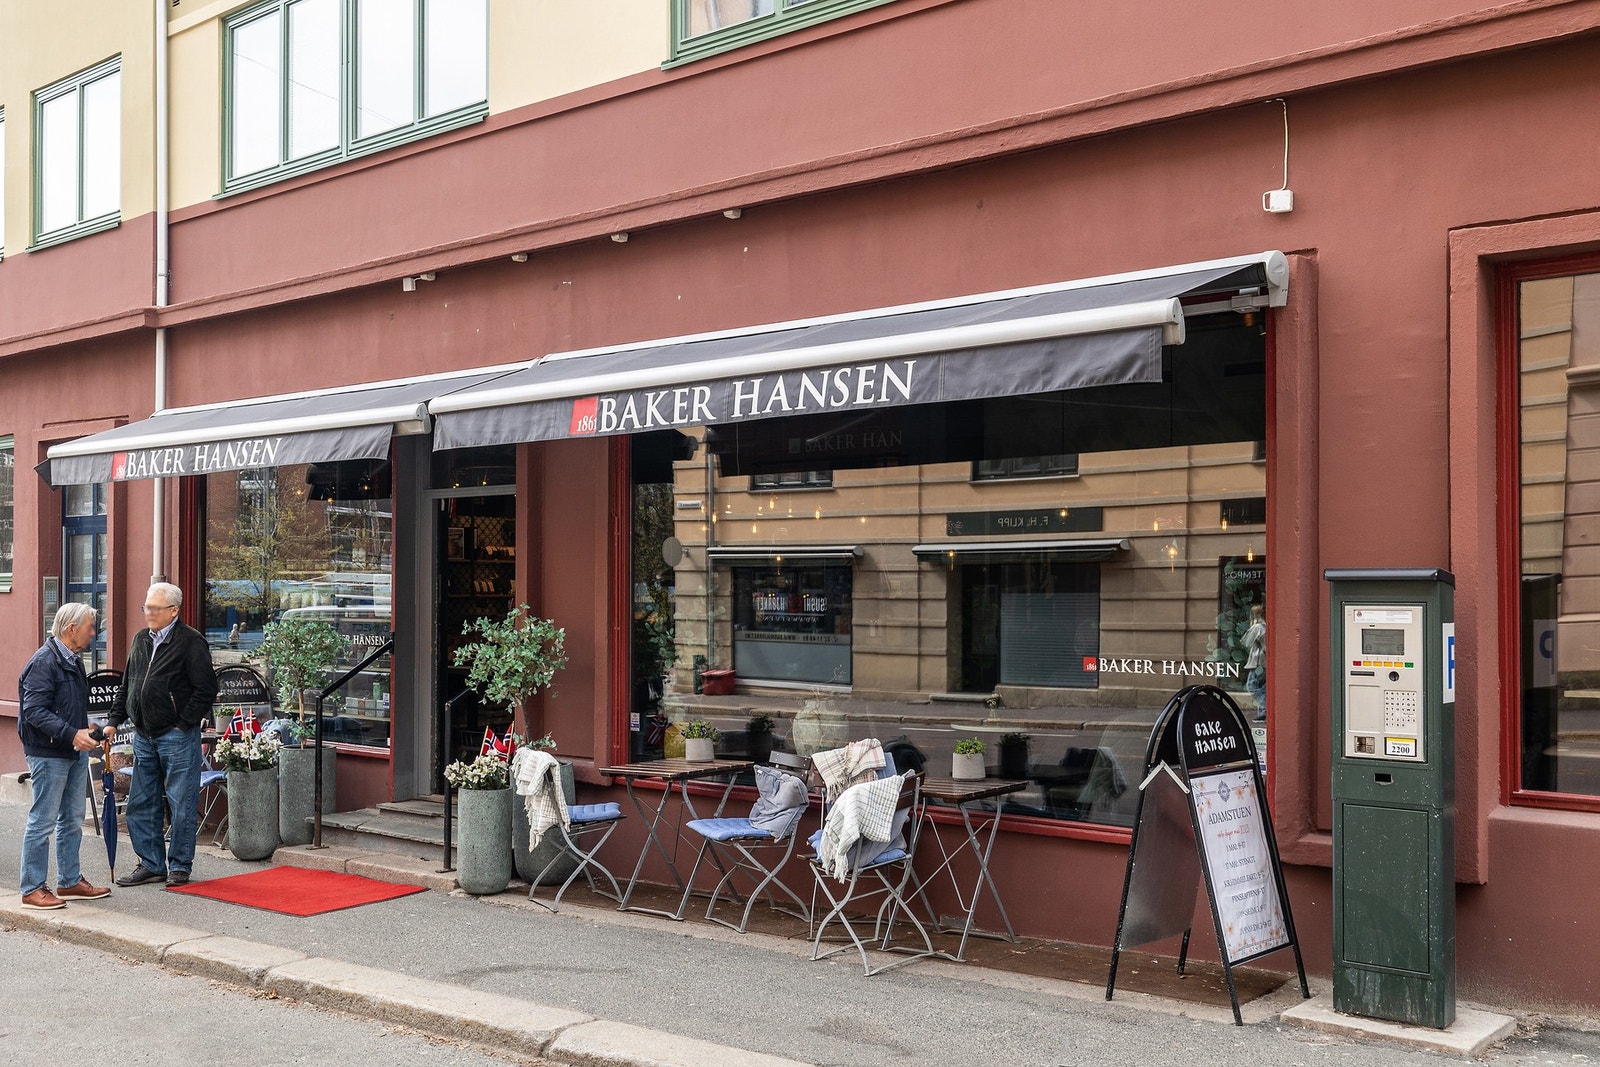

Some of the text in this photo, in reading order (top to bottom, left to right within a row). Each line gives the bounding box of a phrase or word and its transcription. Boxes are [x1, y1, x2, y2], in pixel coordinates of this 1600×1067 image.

[576, 360, 917, 433] 1861 BAKER HANSEN
[126, 448, 185, 478] BAKER
[193, 438, 281, 472] HANSEN
[353, 634, 386, 646] HANSEN
[1099, 657, 1156, 675] BAKER
[1162, 660, 1240, 679] HANSEN
[1391, 746, 1410, 754] 2200
[1208, 806, 1252, 825] ADAMSTUEN
